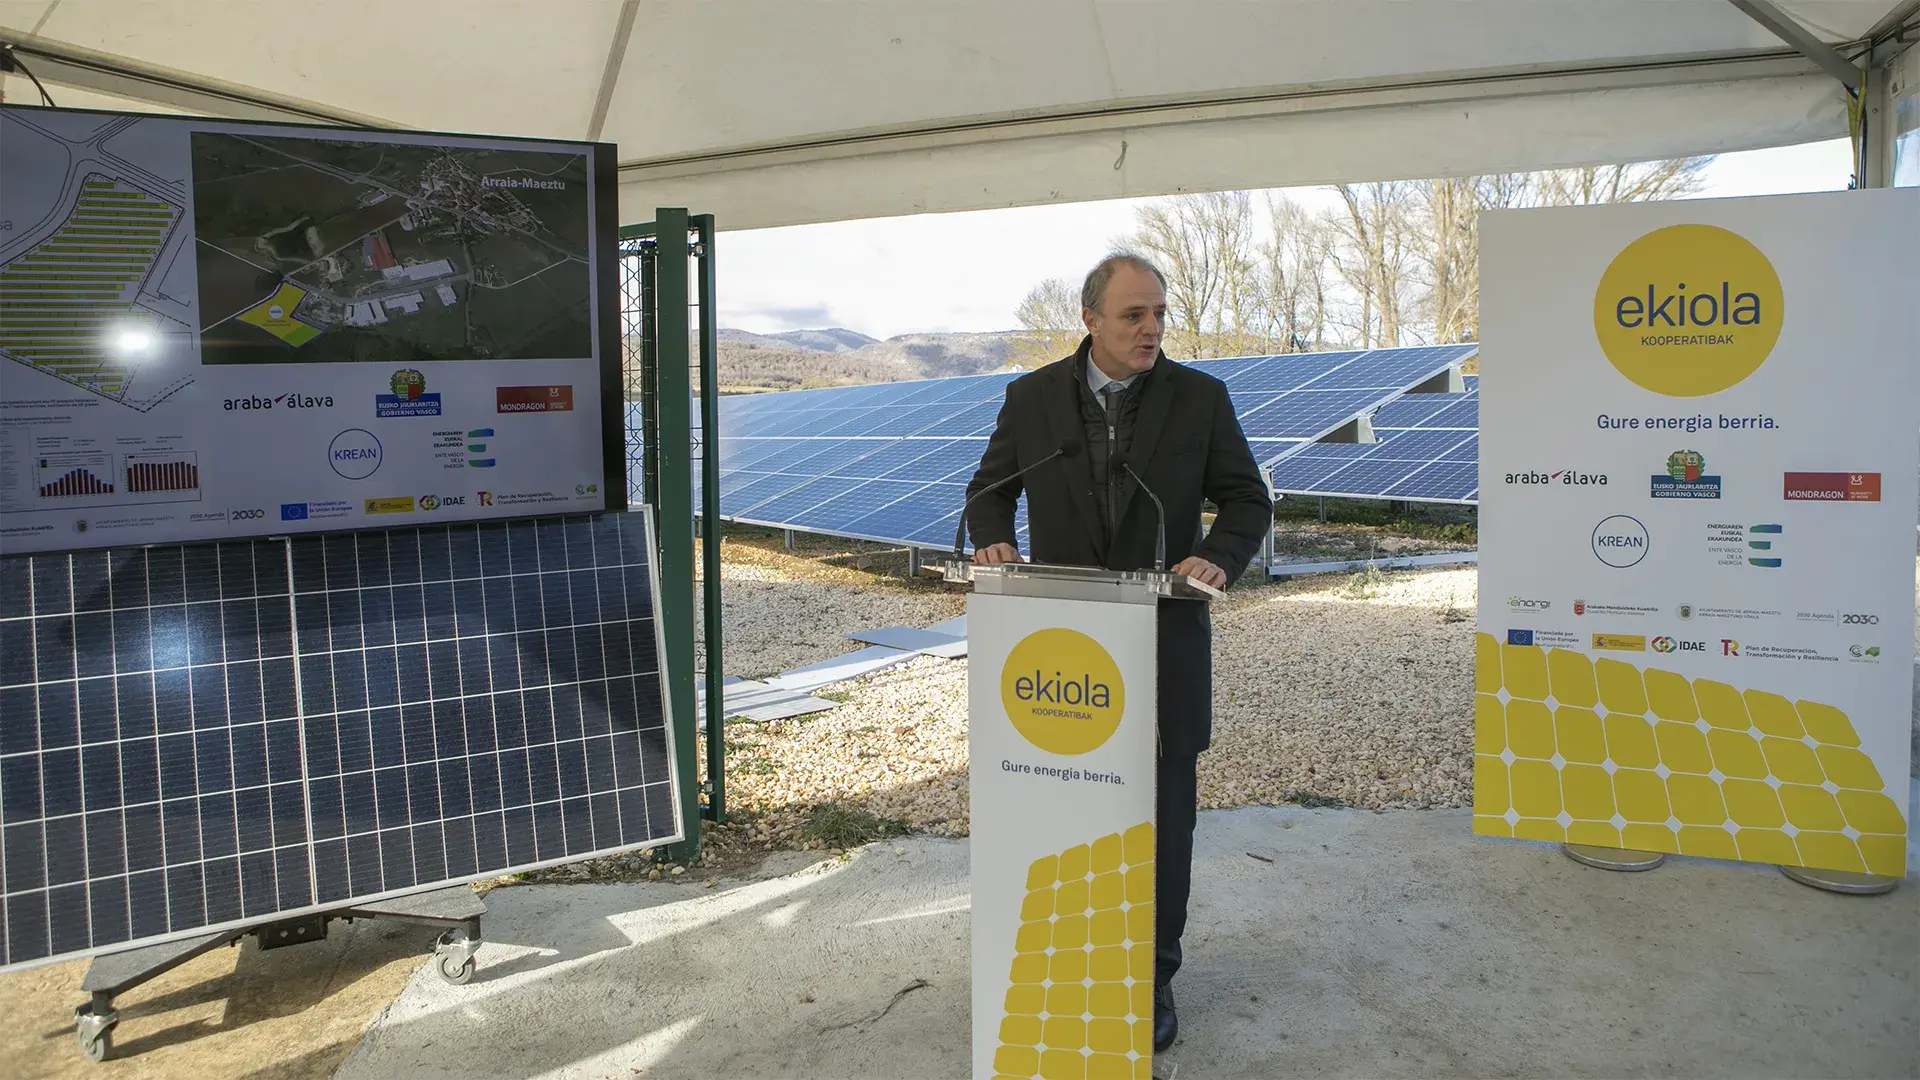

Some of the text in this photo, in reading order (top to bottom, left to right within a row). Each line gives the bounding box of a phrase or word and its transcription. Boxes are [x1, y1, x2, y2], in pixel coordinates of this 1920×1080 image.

[481, 176, 566, 190] Arraia-Maeztu
[1616, 281, 1761, 328] ekiola
[1641, 334, 1734, 346] KOOPERATIBAK
[224, 393, 334, 410] araba álava
[500, 402, 545, 411] MONDRAGON
[1597, 414, 1780, 433] Gure energia berria.
[334, 448, 377, 460] KREAN
[1505, 470, 1608, 485] araba álava
[1787, 490, 1844, 499] MONDRAGON
[443, 496, 465, 506] IDAE
[232, 509, 265, 521] 2030
[1598, 536, 1643, 548] KREAN
[1842, 613, 1879, 625] 2030
[1679, 641, 1706, 652] IDAE
[1771, 646, 1818, 655] Recuperación,
[1745, 651, 1796, 659] Transformación
[1803, 654, 1838, 662] Resiliencia
[1015, 669, 1110, 708] ekiola
[1031, 707, 1093, 720] KOOPERATIBAK
[1001, 759, 1125, 785] Gure energia berria.
